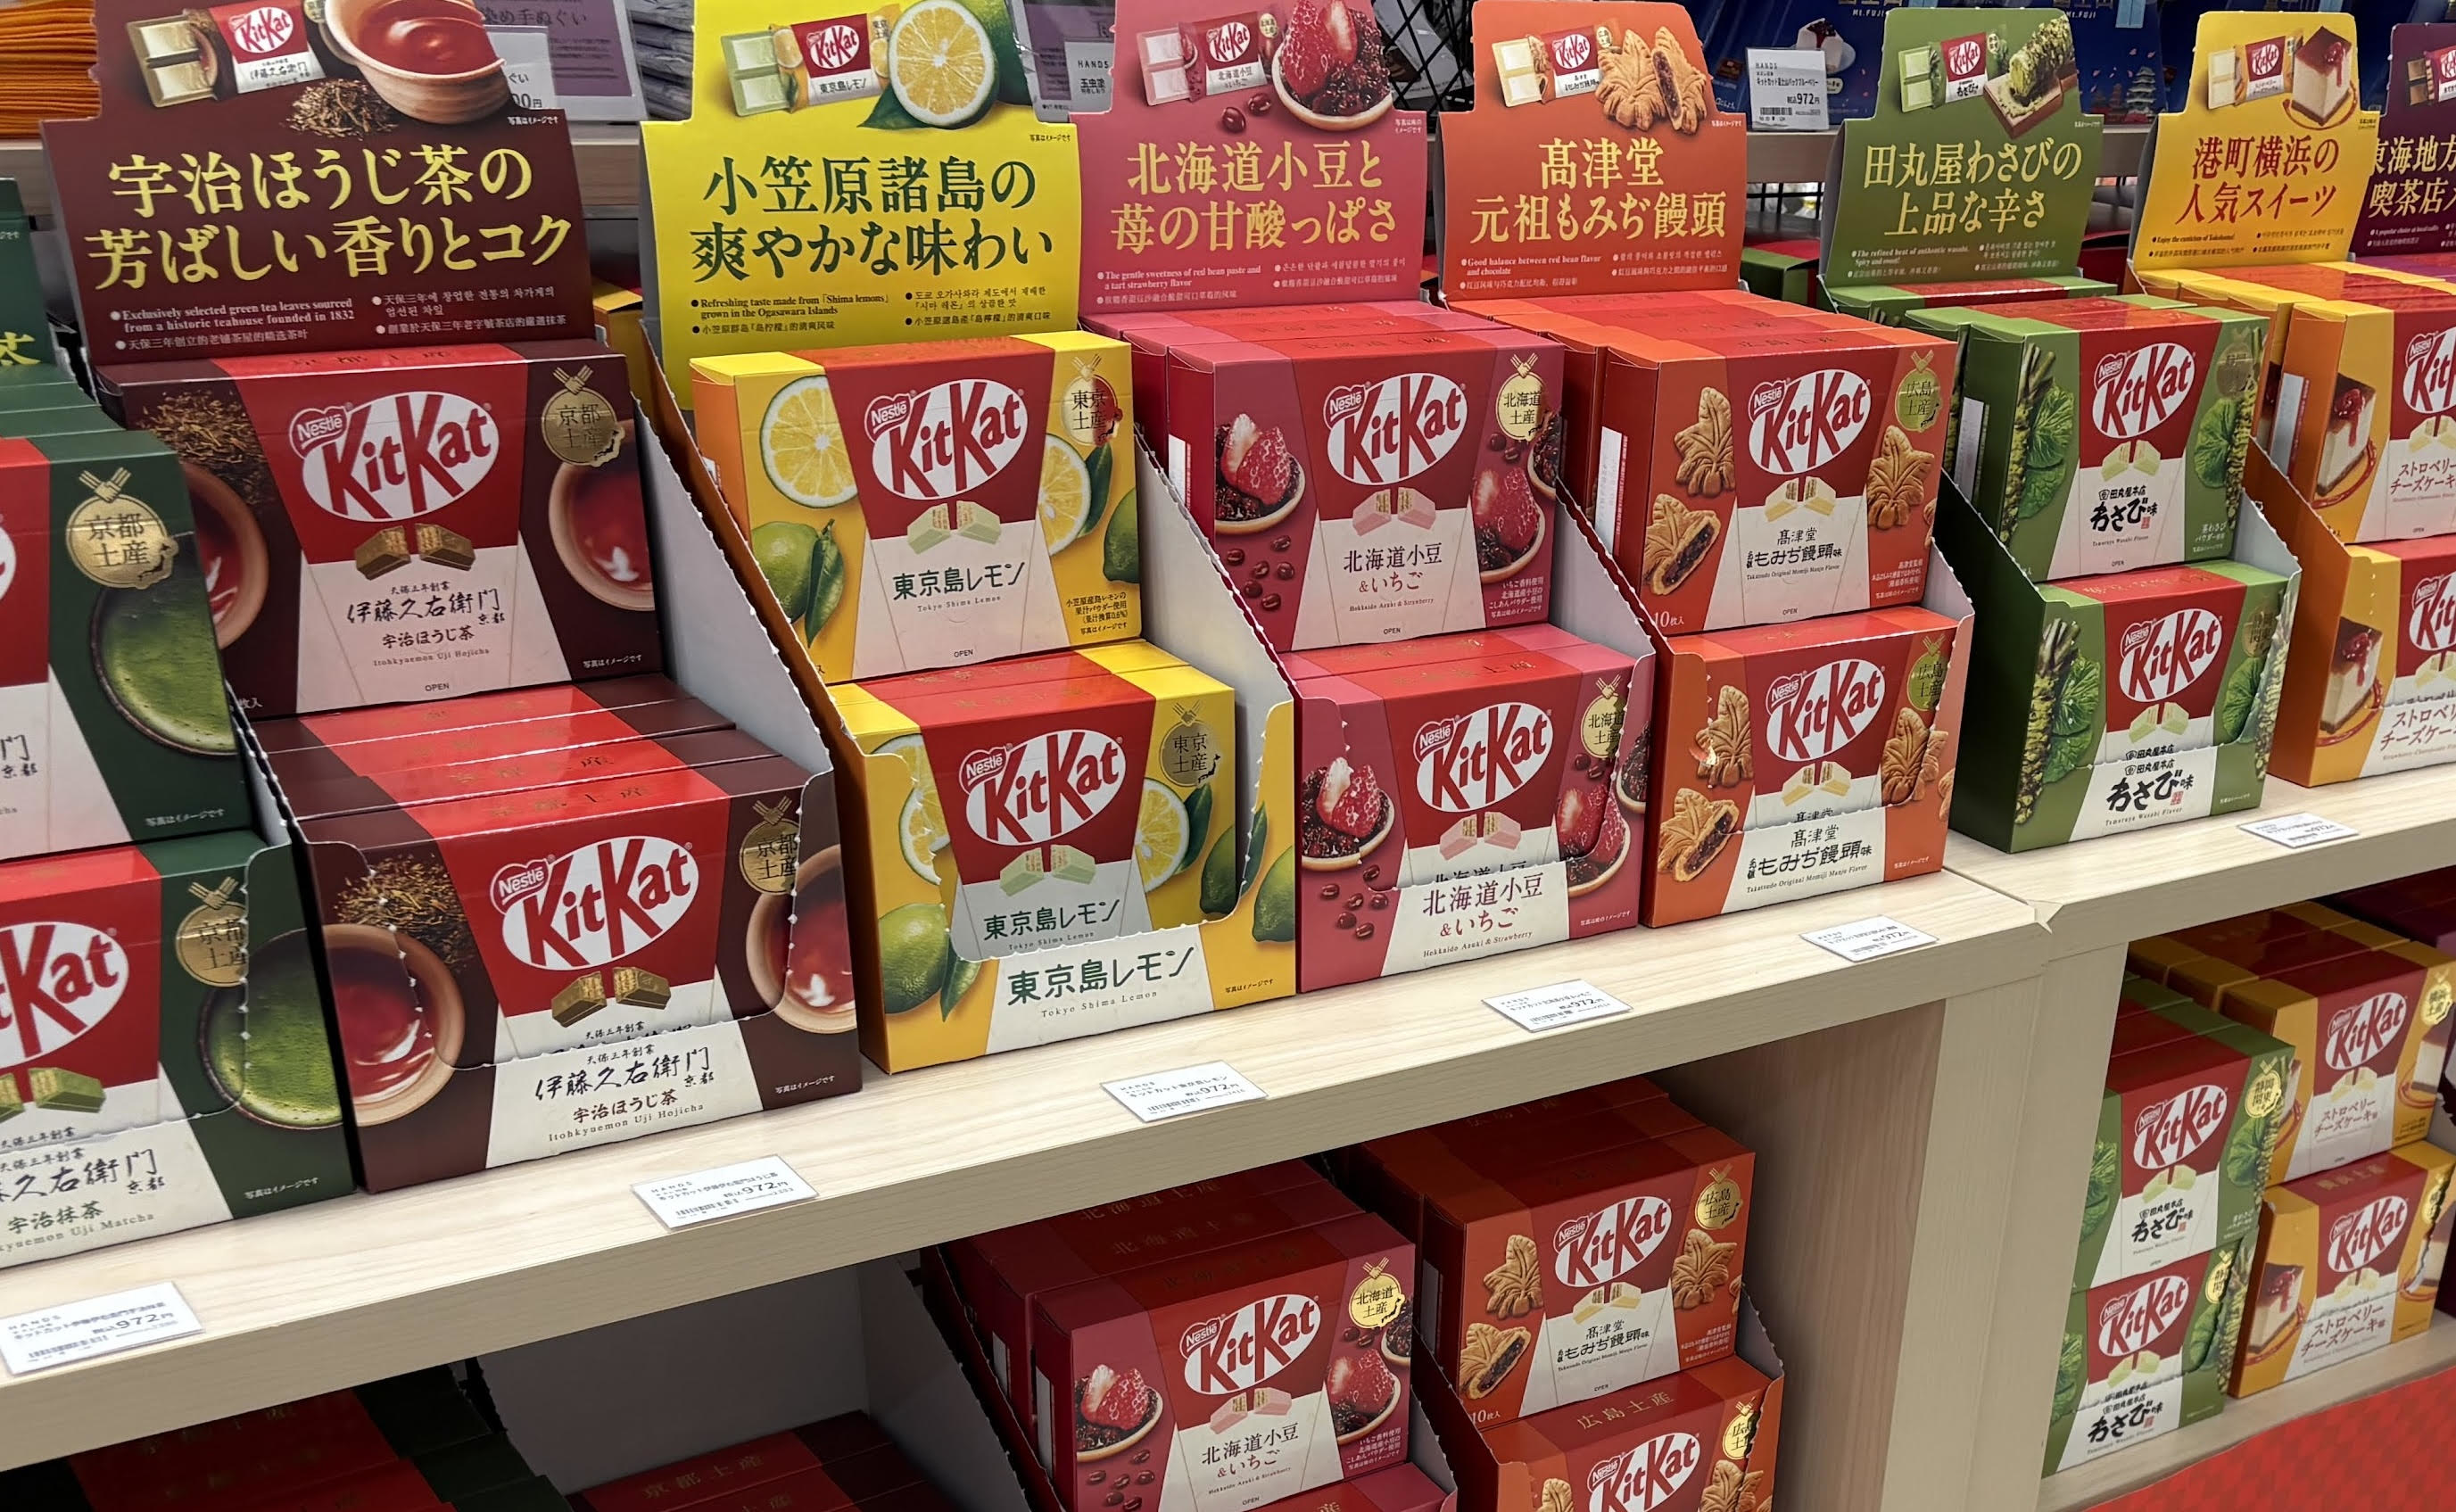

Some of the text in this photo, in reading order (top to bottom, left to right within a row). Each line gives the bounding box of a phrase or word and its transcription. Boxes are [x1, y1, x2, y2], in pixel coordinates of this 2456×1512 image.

[241, 10, 291, 52] KitKat
[1213, 24, 1249, 60] KitKat
[813, 26, 856, 69] KitKat
[1556, 34, 1590, 69] KitKat
[1127, 140, 1383, 195] 北海道小豆と
[1863, 137, 2083, 189] 田丸屋わさびの
[2192, 136, 2339, 179] 港町横浜の
[108, 145, 532, 218] 宇治ほうじ茶の
[702, 155, 1036, 216] 小笠原諸島の
[1469, 191, 1727, 244] 元祖もみぢ饅頭
[1884, 188, 2046, 237] 上品な辛さ
[2175, 181, 2336, 225] 人気スイーツ
[1111, 198, 1395, 254] 苺の甘酸っぱさ
[84, 214, 572, 290] 芳ばしい香りとコク
[690, 218, 1053, 284] 爽やかな味わい
[1468, 254, 1601, 267] Good balance between red bean flavor
[1467, 268, 1511, 276] and chocolate
[122, 298, 352, 320] Exclusively selected green tea leaves sourced
[125, 322, 153, 333] from
[166, 318, 211, 330] historic
[214, 316, 263, 327] teahouse
[267, 312, 312, 325] founded
[315, 311, 326, 322] in
[331, 310, 354, 320] 1832
[701, 305, 839, 319] grown in the Ogasawara Islands
[1071, 388, 1104, 409] 東京
[1329, 391, 1364, 414] Nestlé
[1503, 391, 1542, 408] 北海道
[1906, 381, 1932, 399] 広島
[2101, 346, 2191, 436] KitKat
[556, 403, 600, 426] 京都
[871, 401, 908, 428] Nestlé
[1073, 410, 1104, 432] 土産
[1509, 409, 1535, 426] 土産
[1760, 371, 1868, 473] KitKat
[1906, 399, 1932, 417] 土産
[296, 414, 343, 442] Nestlé
[889, 382, 1021, 499] KitKat
[1344, 375, 1461, 483] KitKat
[321, 394, 492, 520] KitKat
[87, 513, 145, 539] 京都
[2090, 498, 2158, 532] わさび味
[93, 541, 150, 567] 土産
[1343, 541, 1443, 574] 北海道小豆
[892, 561, 1025, 600] 東京島レモン
[1359, 570, 1425, 593] &いちご
[347, 588, 500, 624] 伊藤久右衛門
[1652, 611, 1685, 628] 10枚入
[1782, 607, 1798, 616] OPEN
[382, 625, 475, 649] 宇治ほうじ茶
[1080, 622, 1127, 635] 写真はイメージです
[1383, 626, 1402, 635] OPEN
[583, 653, 642, 669] 写真はイメージです
[954, 649, 973, 658] OPEN
[2129, 610, 2219, 700] KitKat
[1918, 662, 1943, 680] 広島
[425, 682, 450, 692] OPEN
[1588, 713, 1623, 728] 北海道
[1778, 661, 1880, 759] KitKat
[1172, 733, 1207, 752] 東京
[1419, 725, 1451, 748] Nestlé
[965, 753, 1004, 779] Nestlé
[1172, 754, 1207, 773] 土産
[1433, 706, 1548, 810] KitKat
[2137, 757, 2175, 775] 田丸屋本店
[982, 732, 1120, 844] KitKat
[2105, 770, 2194, 813] わさび味
[145, 807, 225, 828] 写真はイメージです
[2105, 806, 2183, 827] Tamaruya Wasabi Flavor
[757, 832, 798, 856] 京都
[498, 864, 545, 896] Nestlé
[759, 856, 797, 880] 土産
[1747, 863, 1868, 894] Takatsudo Original Momiji Manju Flavor
[523, 838, 691, 969] KitKat
[1423, 872, 1544, 916] 北海道小豆
[983, 898, 1120, 940] 東京島レモン
[1440, 906, 1520, 937] &いちご
[1423, 944, 1460, 958] Hokkaido
[1461, 940, 1484, 952] Azuki
[1493, 930, 1533, 946] Strawberry
[1006, 946, 1195, 1007] 東京島レモン
[1224, 978, 1274, 995] 写真はイメージです
[1041, 989, 1158, 1020] Tokyo Shima Lemon
[2328, 995, 2402, 1069] KitKat
[535, 1046, 709, 1101] 伊藤久右衛門
[775, 1074, 835, 1095] 写真はイメージです
[573, 1088, 678, 1124] 宇治ほうじ茶
[2323, 1099, 2376, 1121] ストロベリー
[549, 1103, 705, 1142] Itohkyuemon Uji Hojicha
[2138, 1086, 2225, 1168] KitKat
[244, 1177, 318, 1201] 写真はイメージです
[650, 1181, 693, 1194] HANDS
[1705, 1189, 1731, 1206] 広島
[6, 1200, 106, 1235] 宇治抹茶
[1705, 1202, 1730, 1219] 土産
[2131, 1205, 2194, 1243] わさび味
[1568, 1199, 1666, 1284] KitKat
[2335, 1199, 2405, 1270] KitKat
[1355, 1287, 1394, 1305] 北海道
[1363, 1302, 1388, 1318] 土産
[2104, 1278, 2187, 1355] KitKat
[2313, 1305, 2384, 1337] ストロベリー
[1187, 1323, 1218, 1345] Nestlé
[1199, 1296, 1315, 1392] KitKat
[1577, 1391, 1675, 1430] 広島土産
[2088, 1400, 2163, 1443] わさび味
[1202, 1424, 1299, 1465] 北海道小豆
[1218, 1451, 1278, 1478] &いちご
[1600, 1434, 1696, 1512] KitKat
[1243, 1496, 1260, 1506] OPEN
